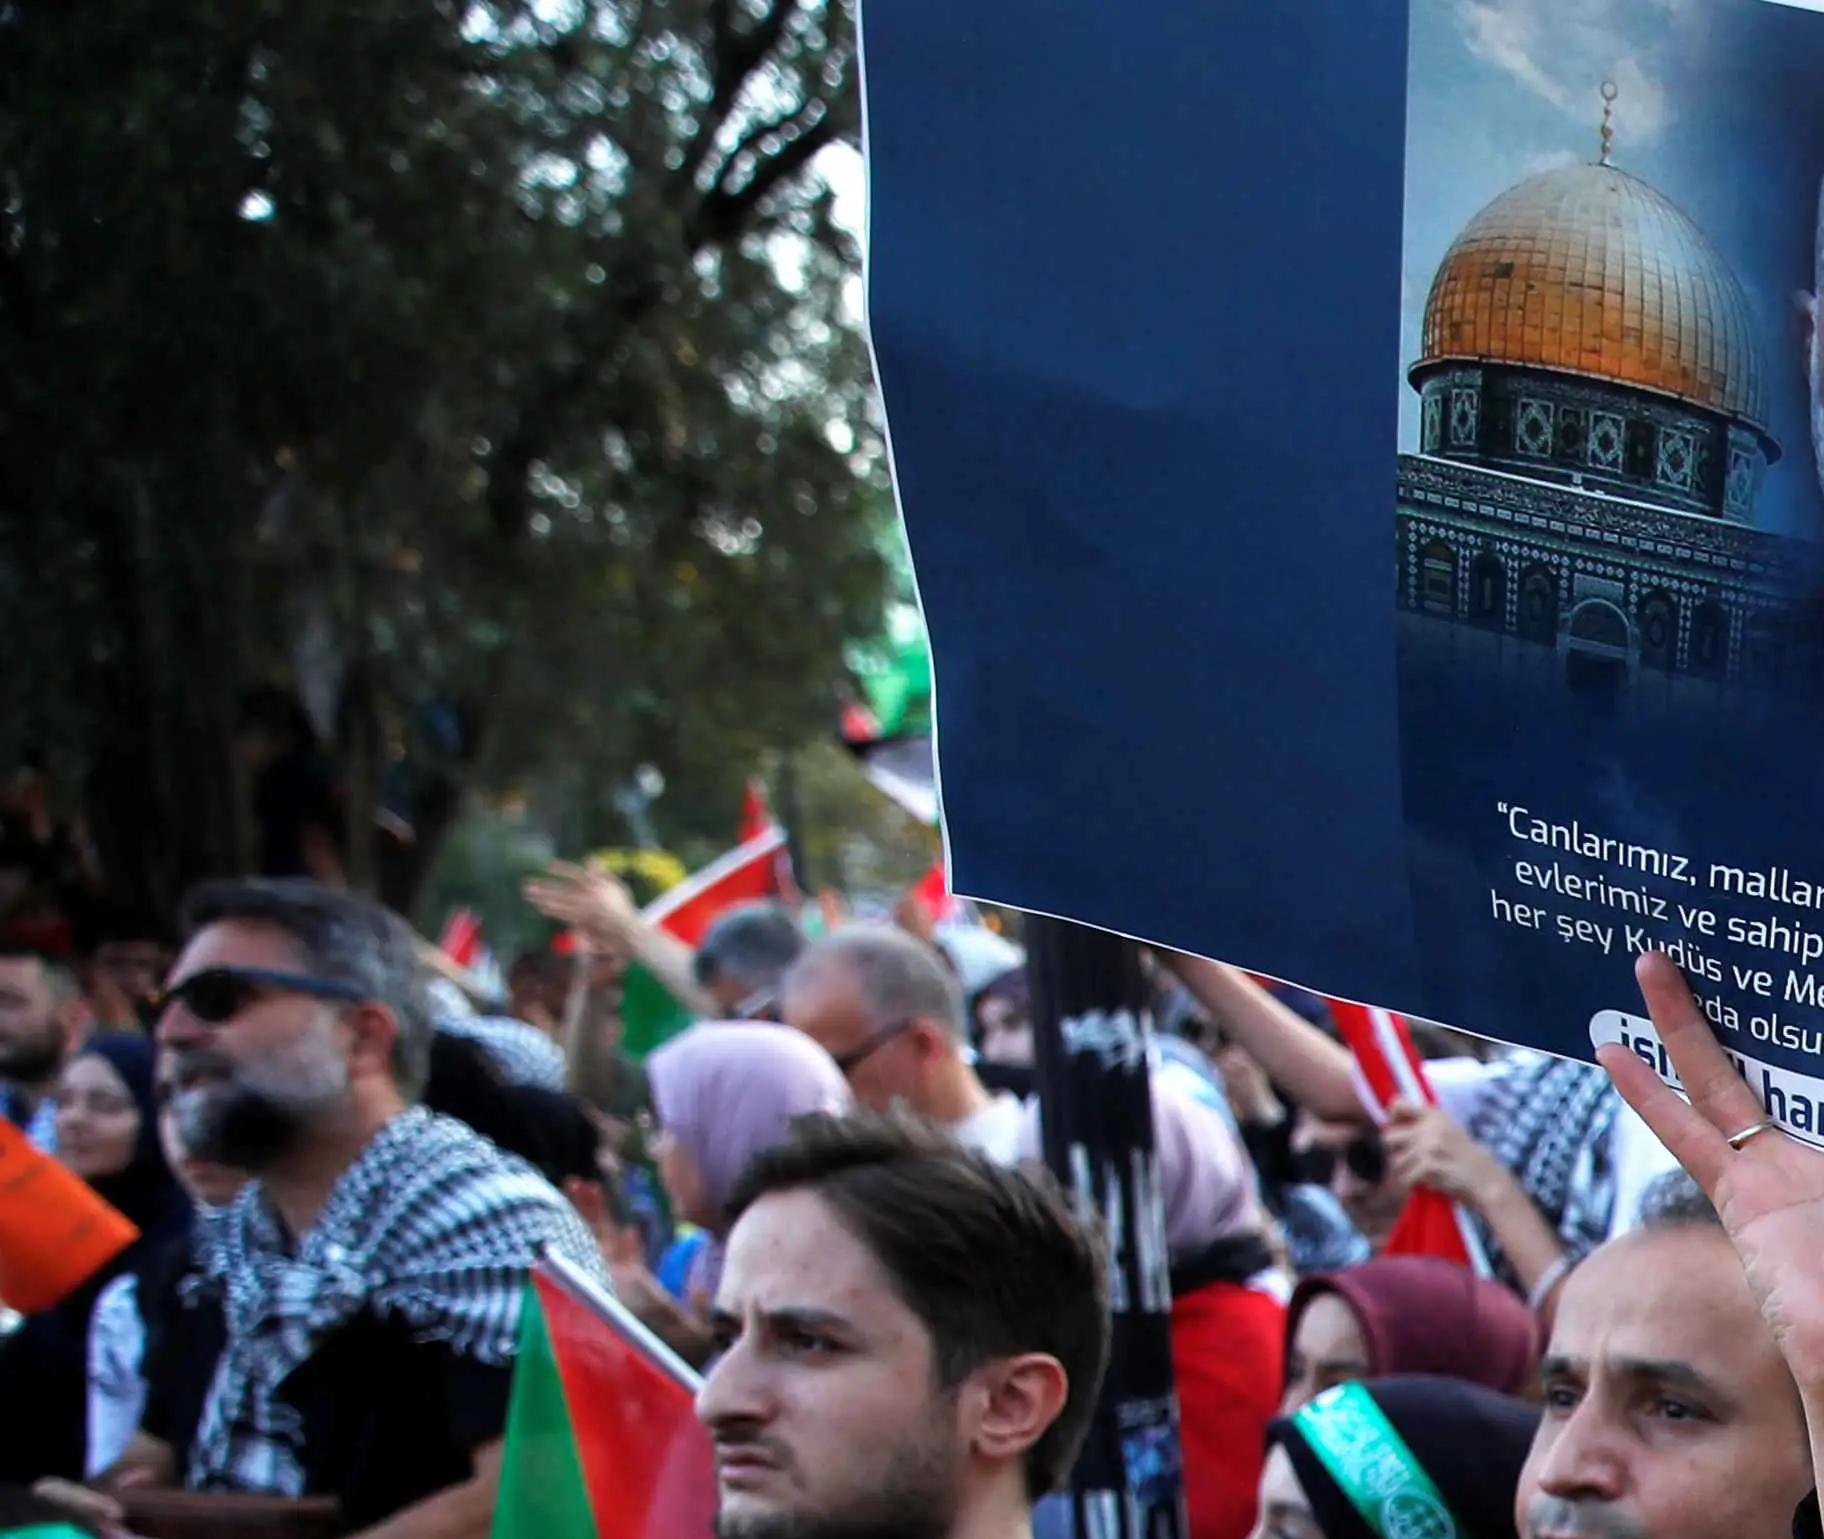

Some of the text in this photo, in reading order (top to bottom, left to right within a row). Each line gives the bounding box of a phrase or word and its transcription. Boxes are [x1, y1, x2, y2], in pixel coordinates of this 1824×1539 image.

[1497, 801, 1697, 886] “Canlarımız,
[1490, 888, 1547, 929] her
[1556, 914, 1613, 955] şey
[1732, 965, 1773, 997] ve
[1515, 860, 1669, 921] evlerimiz
[1677, 904, 1717, 936] ve
[1726, 916, 1824, 966] sahip
